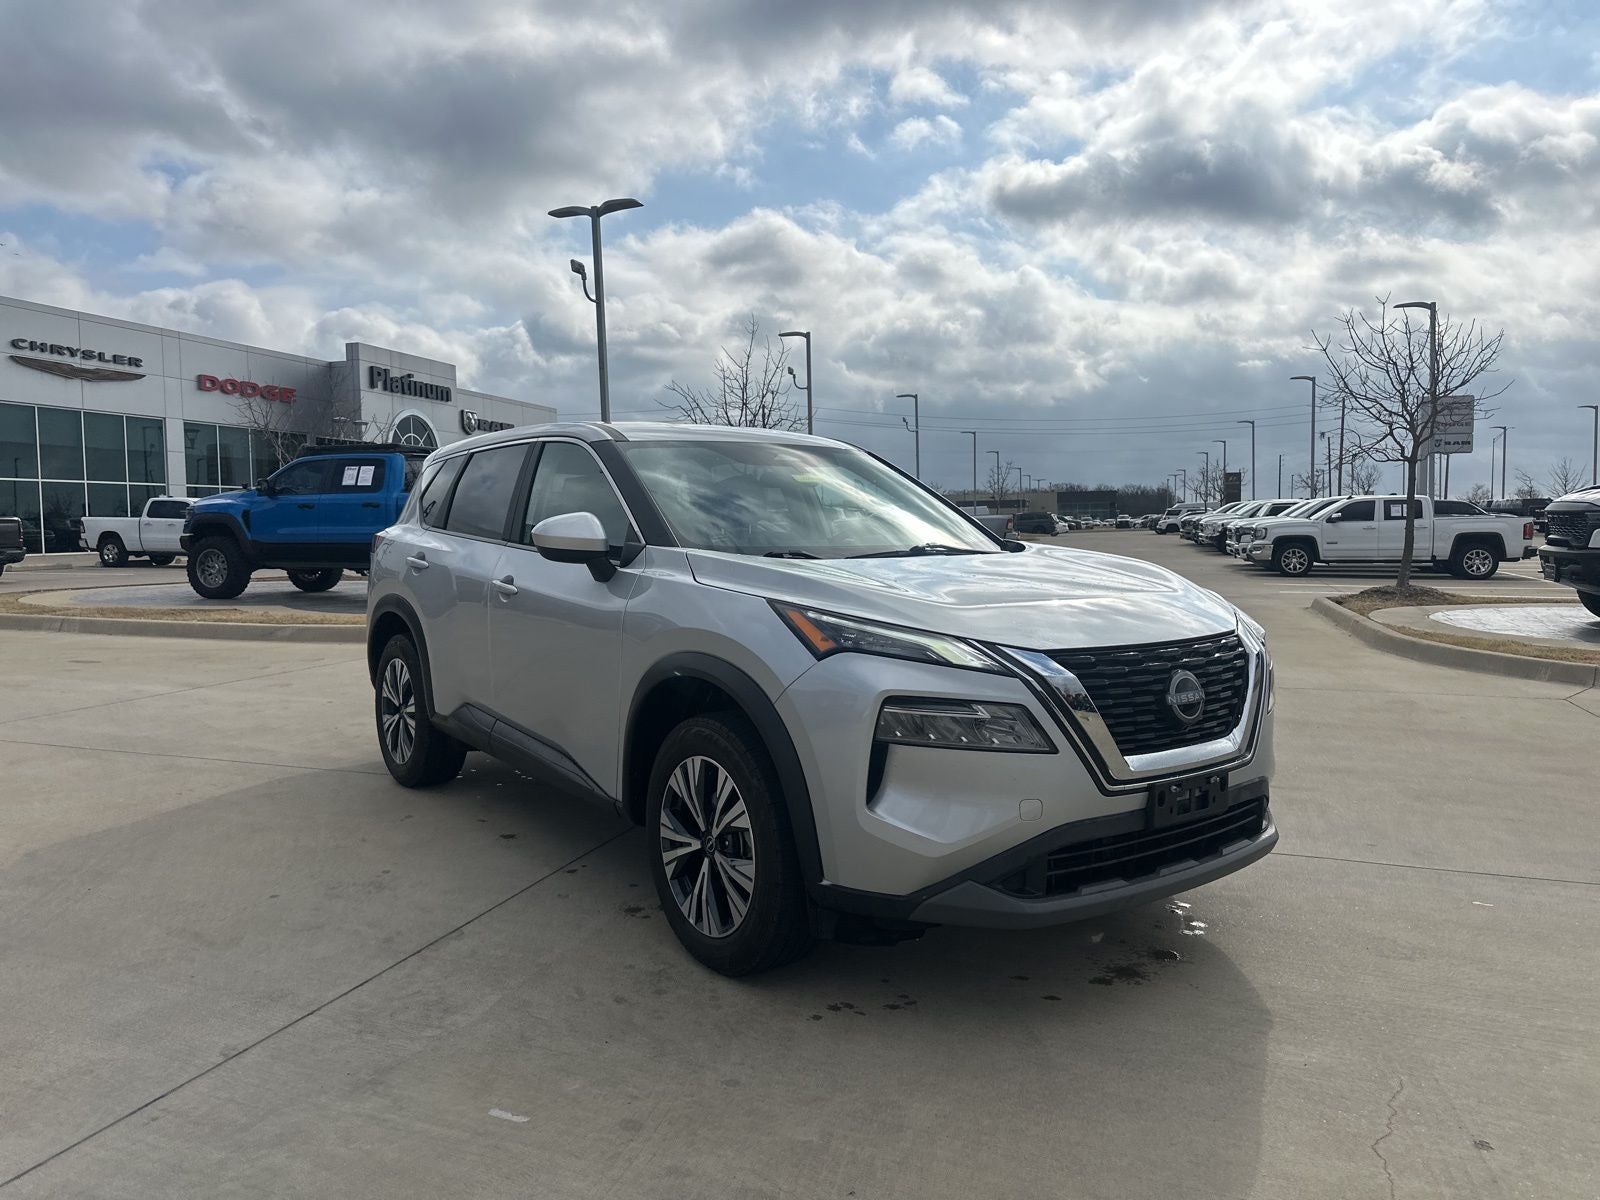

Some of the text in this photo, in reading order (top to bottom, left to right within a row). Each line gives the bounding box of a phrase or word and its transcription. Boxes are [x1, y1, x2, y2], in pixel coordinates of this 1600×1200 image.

[10, 338, 143, 367] CHRYSLER
[197, 374, 296, 404] DODGE
[369, 366, 452, 402] Platinum
[1168, 691, 1205, 703] NISSAN
